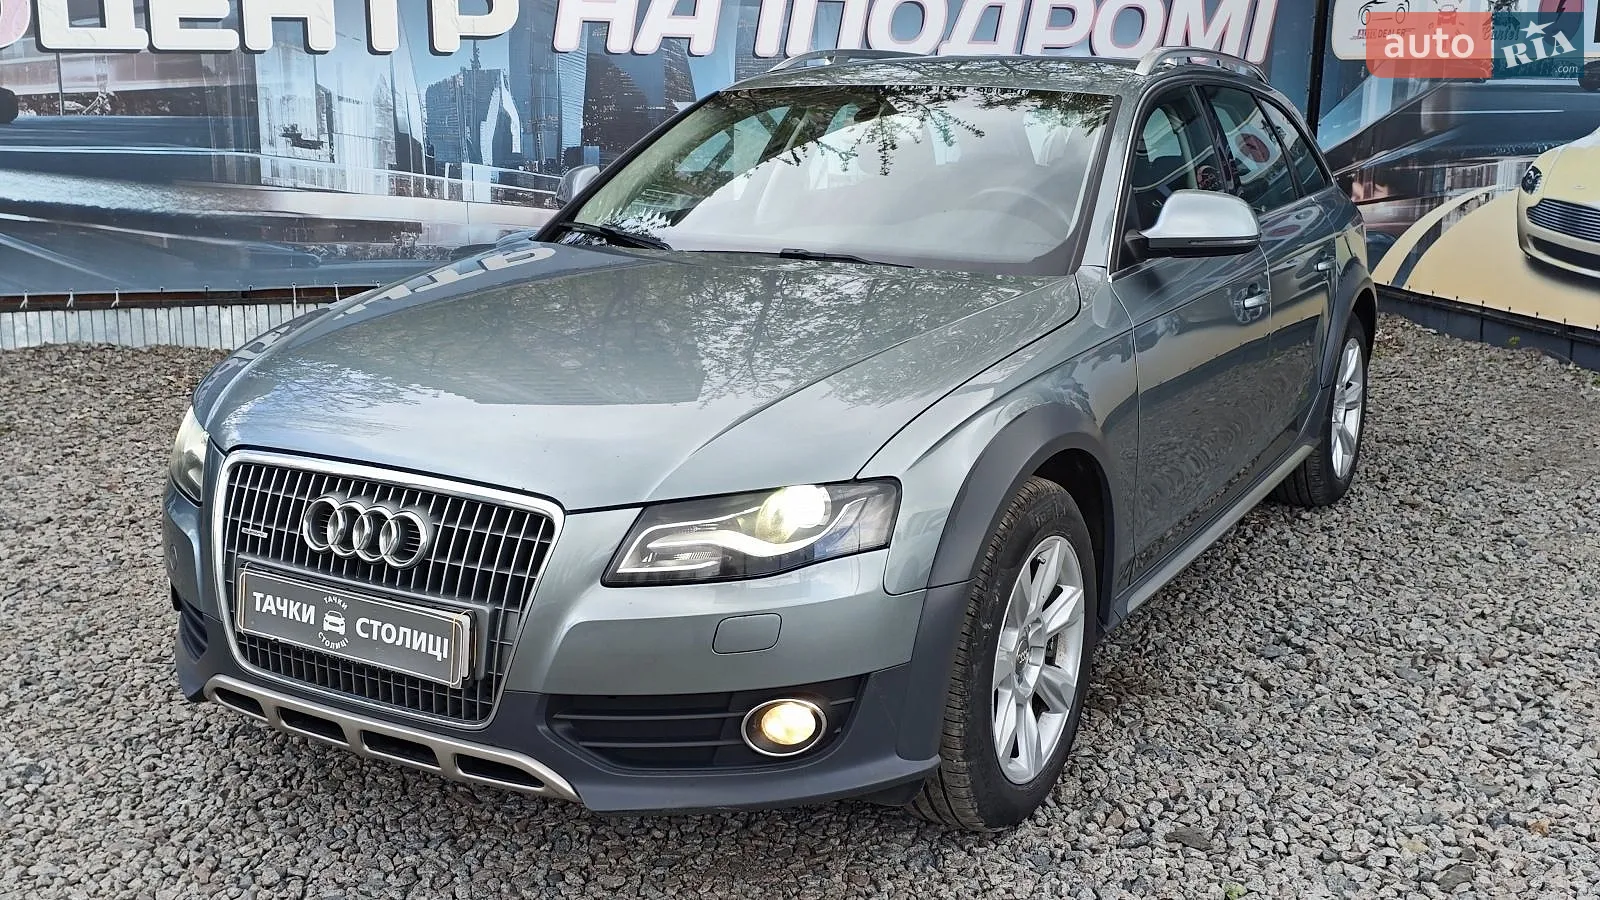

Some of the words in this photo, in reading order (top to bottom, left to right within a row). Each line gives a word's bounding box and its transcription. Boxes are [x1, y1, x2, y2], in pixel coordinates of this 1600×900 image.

[553, 0, 721, 55] НА
[323, 595, 348, 611] ТАЧКИ
[253, 592, 315, 625] ТАЧКИ
[355, 617, 449, 661] СТОЛИЦІ
[318, 631, 349, 650] СТОЛИЦІ
